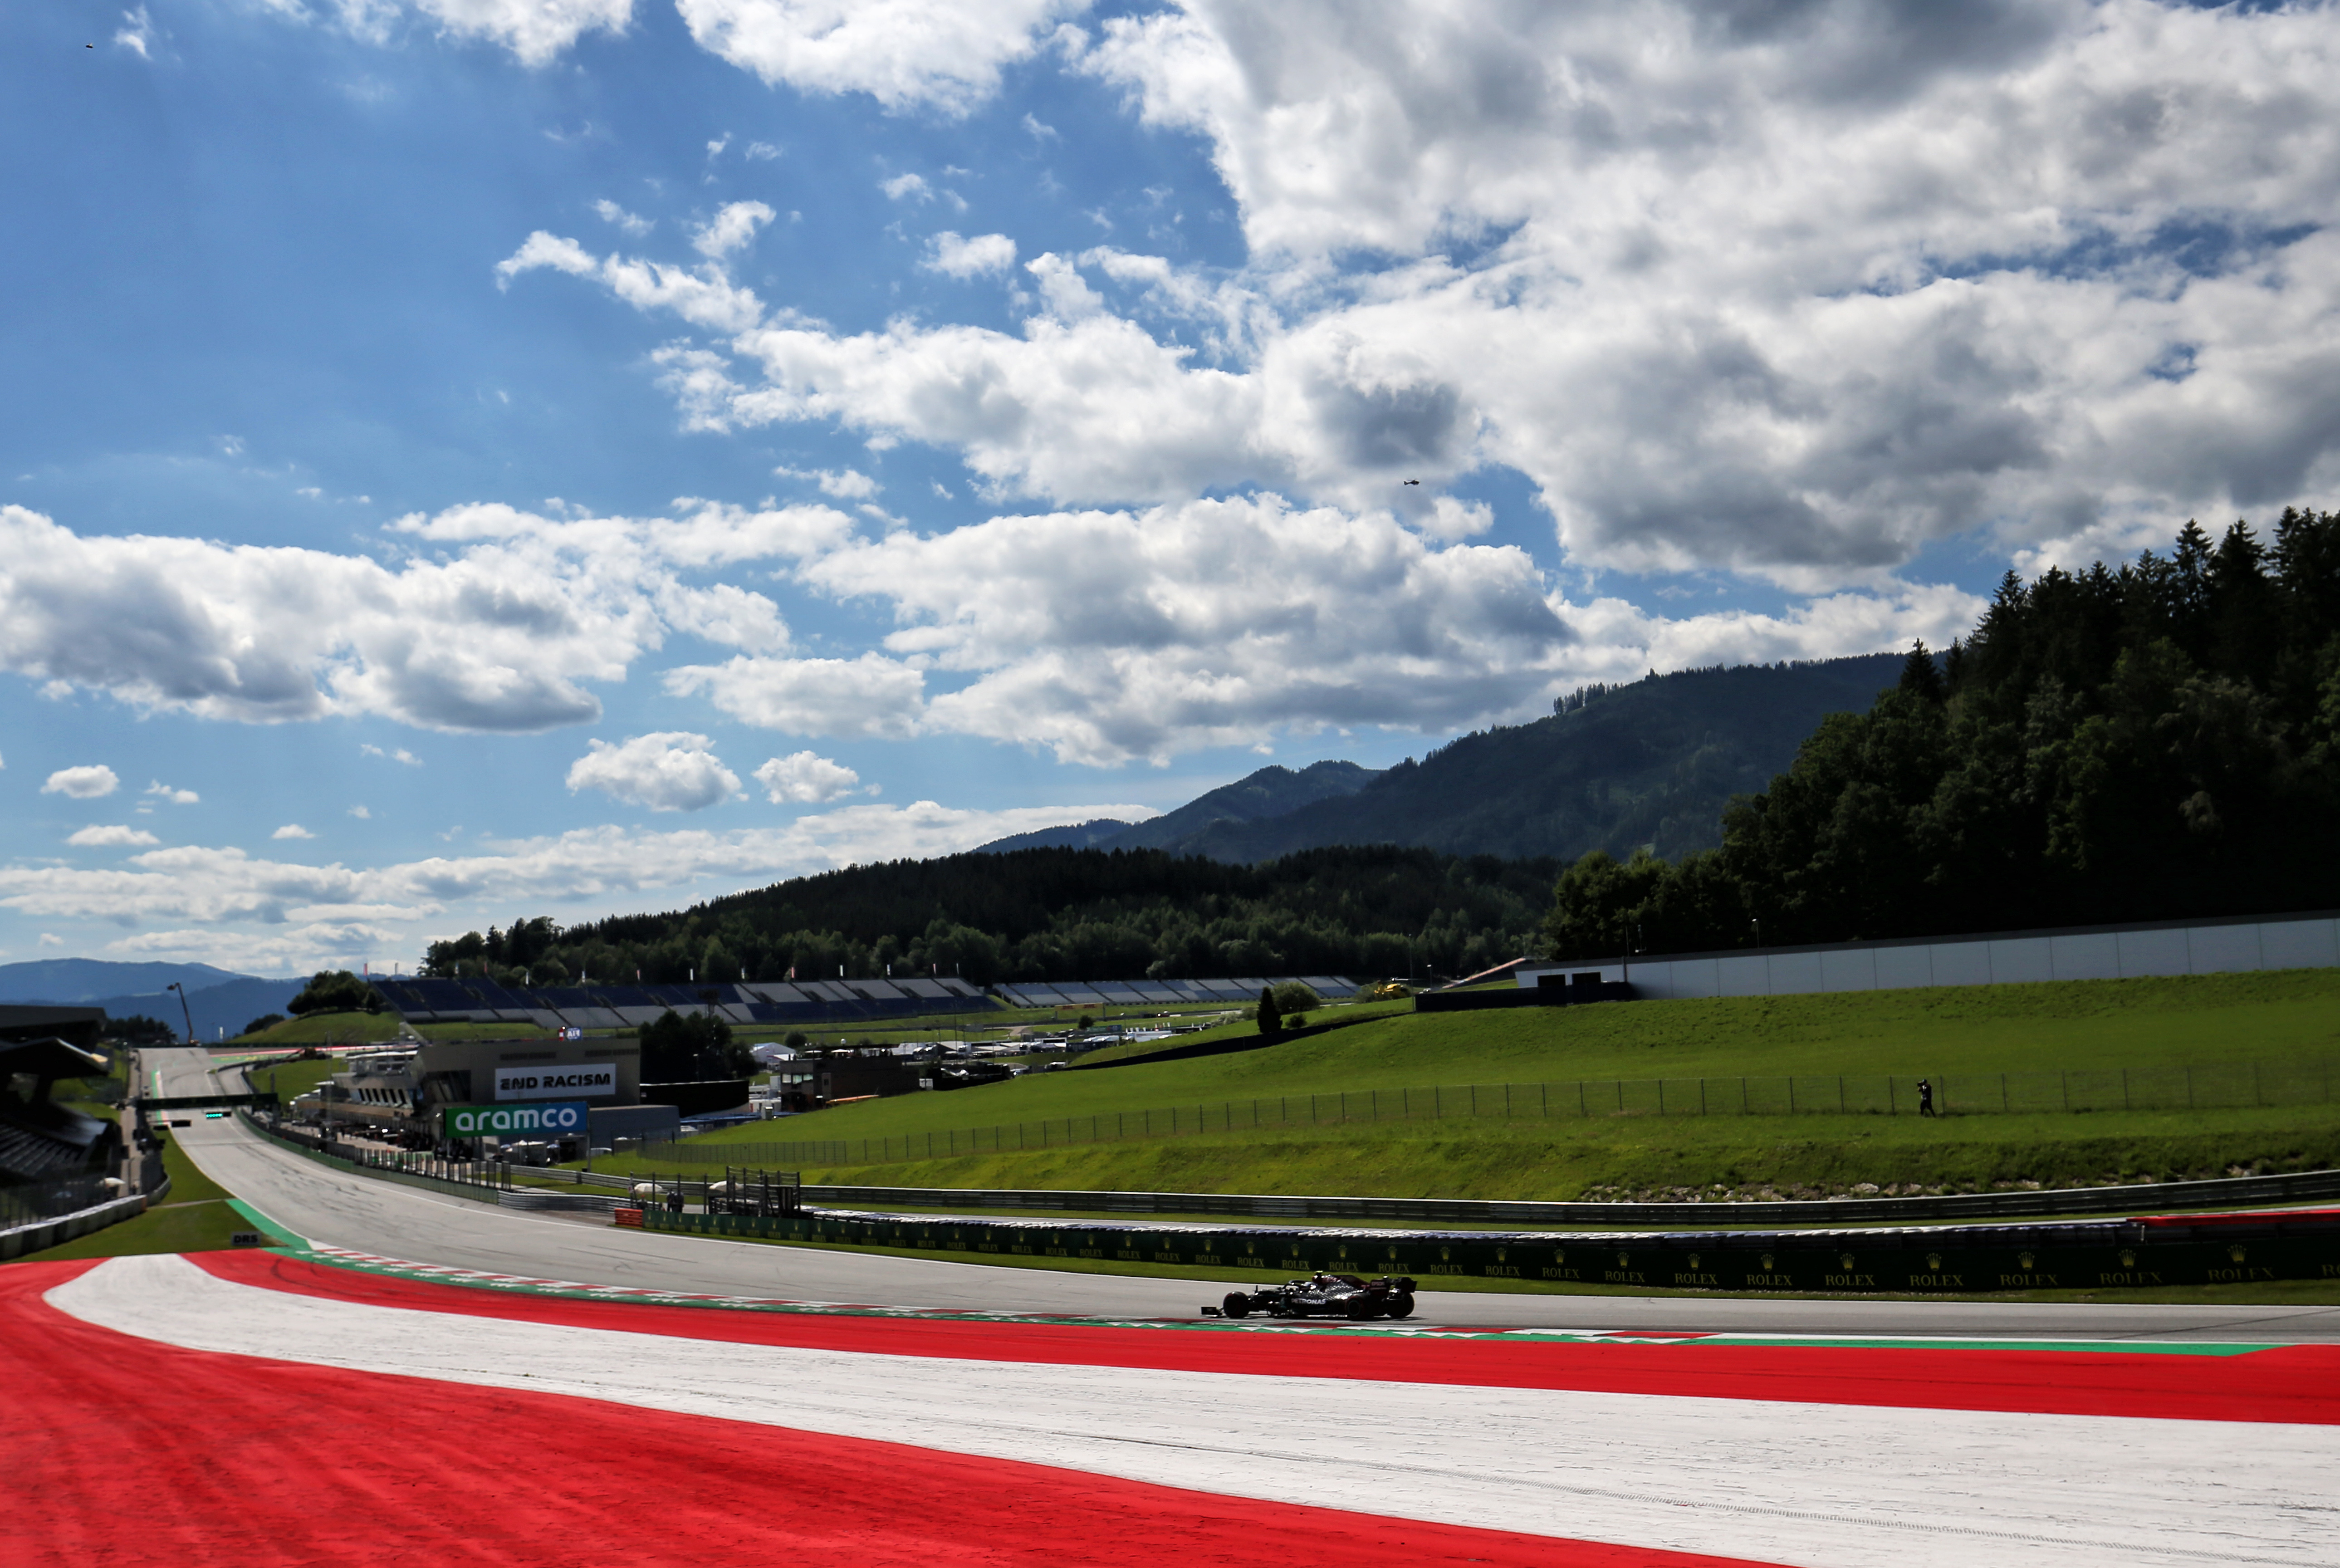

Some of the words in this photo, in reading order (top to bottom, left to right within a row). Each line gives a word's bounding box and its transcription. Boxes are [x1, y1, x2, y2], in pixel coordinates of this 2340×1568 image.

[500, 1077, 538, 1090] END
[543, 1073, 611, 1088] RACISM
[455, 1108, 577, 1132] aramco
[234, 1235, 258, 1243] DRS
[978, 1244, 999, 1252] ROLEX
[1011, 1245, 1033, 1254] ROLEX
[1045, 1247, 1067, 1256] ROLEX
[1080, 1249, 1103, 1257] ROLEX
[1117, 1250, 1141, 1259] ROLEX
[1155, 1252, 1180, 1262] ROLEX
[1195, 1254, 1222, 1264] ROLEX
[1237, 1257, 1265, 1267] ROLEX
[1282, 1259, 1310, 1270] ROLEX
[1329, 1261, 1359, 1271] ROLEX
[1378, 1263, 1410, 1273] ROLEX
[1430, 1264, 1464, 1274] ROLEX
[1485, 1265, 1521, 1276] ROLEX
[1542, 1267, 1580, 1279] ROLEX
[1605, 1270, 1645, 1282] ROLEX
[1675, 1273, 1718, 1285] ROLEX
[1747, 1274, 1793, 1286] ROLEX
[1825, 1274, 1875, 1286] ROLEX
[1909, 1274, 1964, 1286] ROLEX
[2000, 1274, 2059, 1286] ROLEX
[2100, 1272, 2163, 1285] ROLEX
[2208, 1267, 2275, 1282] ROLEX
